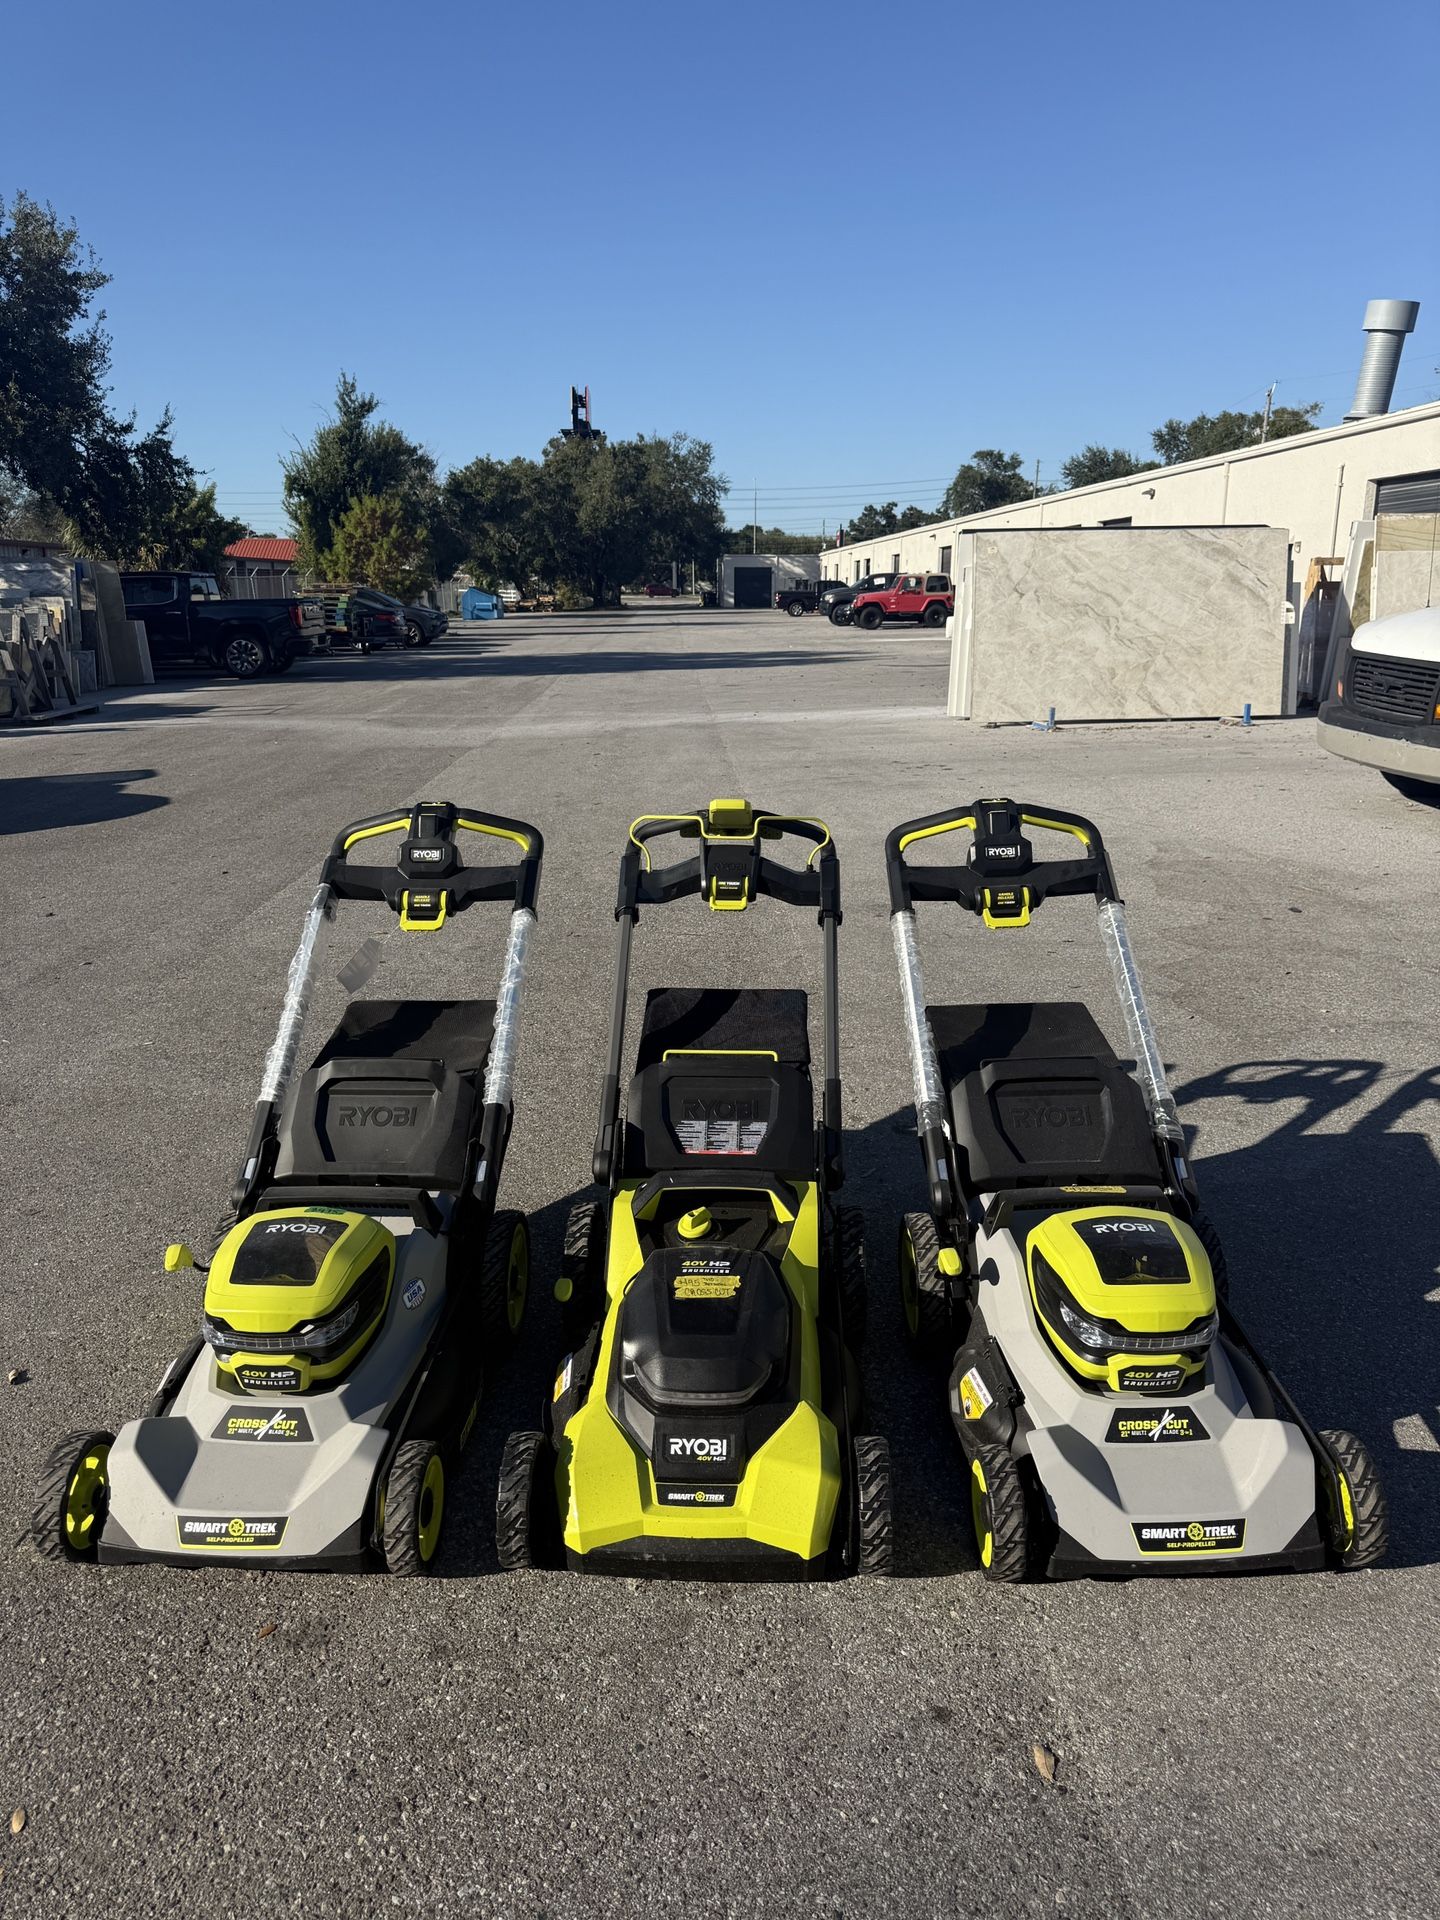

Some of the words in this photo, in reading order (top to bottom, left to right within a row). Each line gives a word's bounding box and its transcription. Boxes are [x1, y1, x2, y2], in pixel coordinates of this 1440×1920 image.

[413, 850, 440, 858] RYOBI
[988, 847, 1016, 856] RYOBI
[339, 1106, 417, 1127] RYOBI
[1010, 1105, 1093, 1128] RYOBI
[265, 1223, 326, 1235] RYOBI
[1092, 1222, 1156, 1234] RYOBI
[407, 1285, 423, 1302] USA
[242, 1370, 268, 1378] 40V
[1125, 1370, 1154, 1379] 40V
[1156, 1370, 1181, 1378] HP
[228, 1418, 268, 1429] CROSS
[273, 1420, 298, 1430] CUT
[1118, 1420, 1160, 1431] CROSS
[1165, 1419, 1189, 1429] CUT
[669, 1438, 727, 1455] RYOBI
[668, 1493, 696, 1501] SMART
[184, 1522, 228, 1533] SMART
[244, 1522, 278, 1533] TREK
[1141, 1527, 1187, 1539] SMART
[1203, 1525, 1237, 1537] TREK
[1166, 1540, 1217, 1548] SELF-PROPELLED
